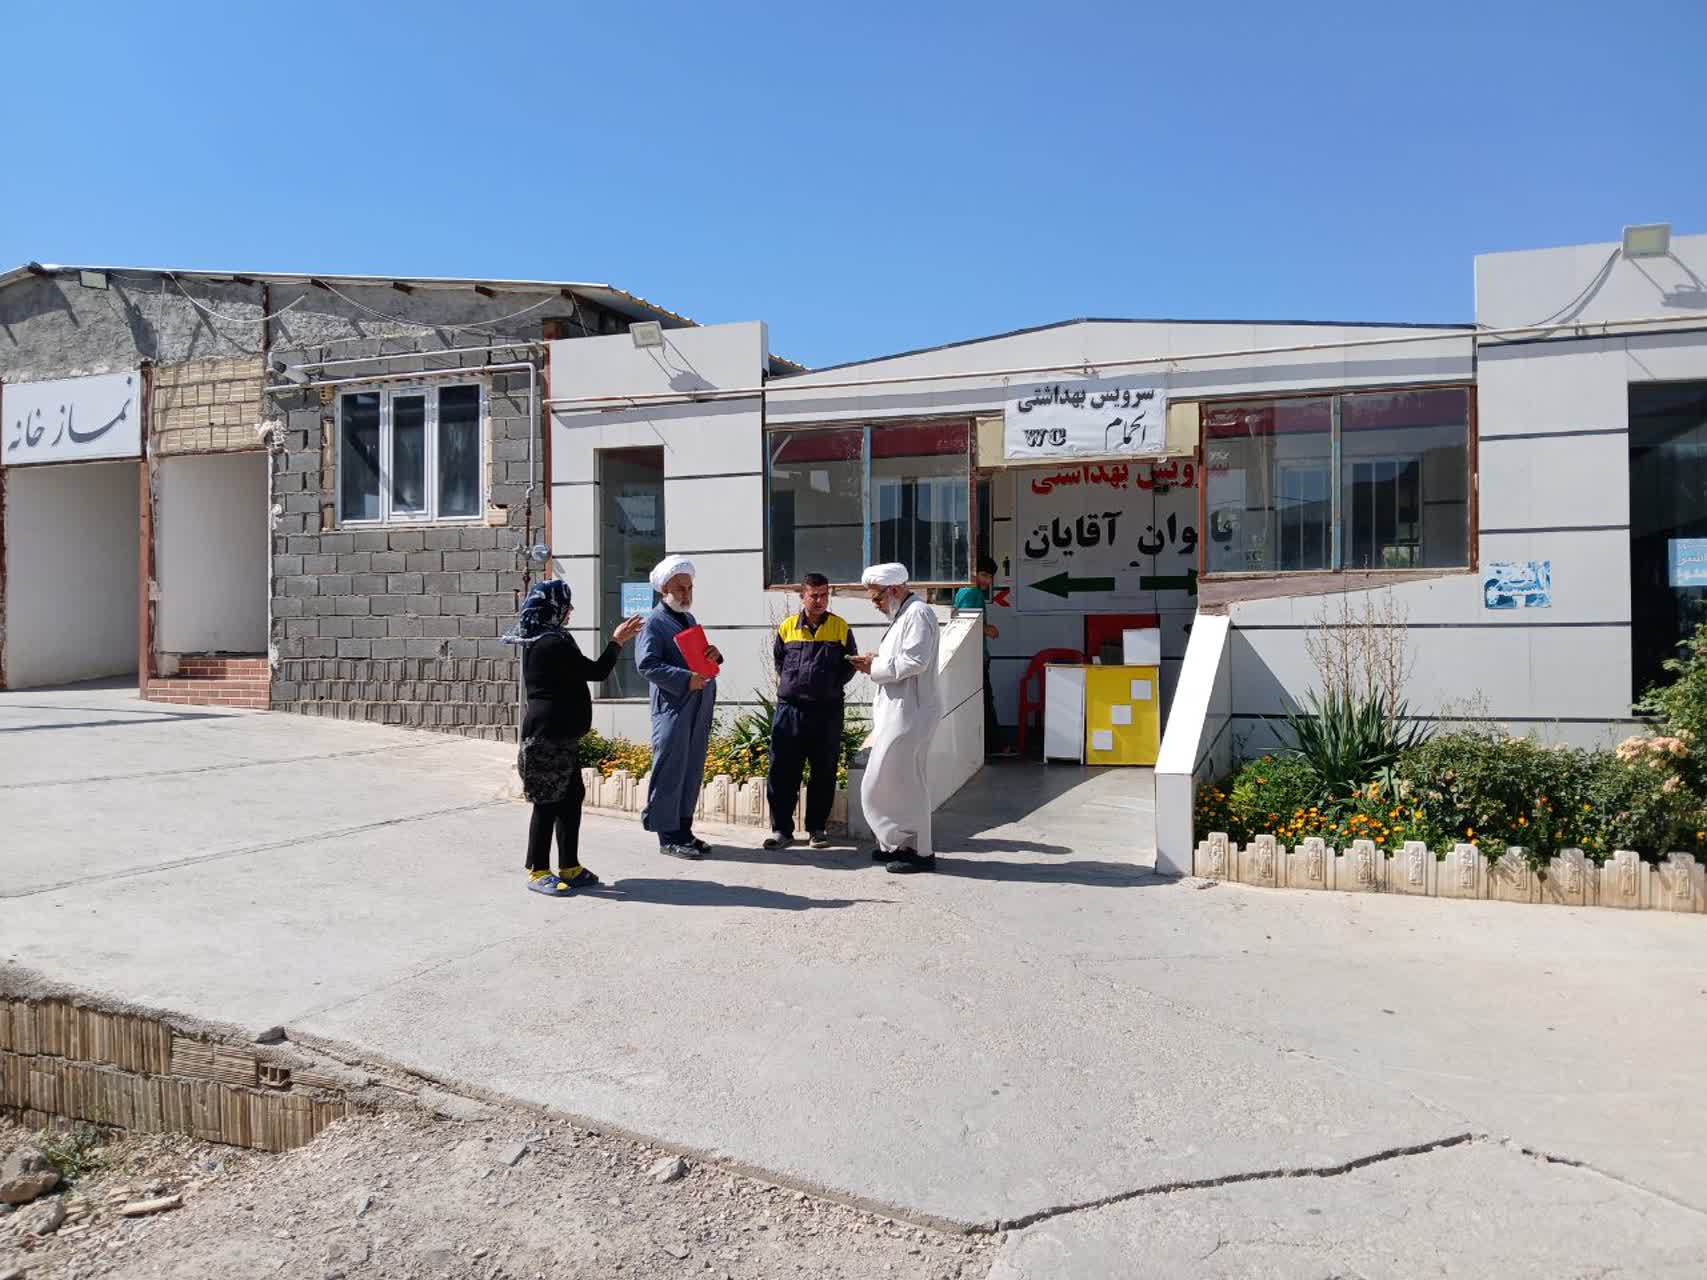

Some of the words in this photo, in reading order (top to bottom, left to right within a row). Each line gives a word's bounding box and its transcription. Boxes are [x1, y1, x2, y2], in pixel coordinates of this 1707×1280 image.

[1018, 385, 1086, 412] بهداشتی
[1090, 387, 1154, 409] سرویس
[1024, 427, 1067, 447] WC
[1024, 511, 1123, 559] آقایان
